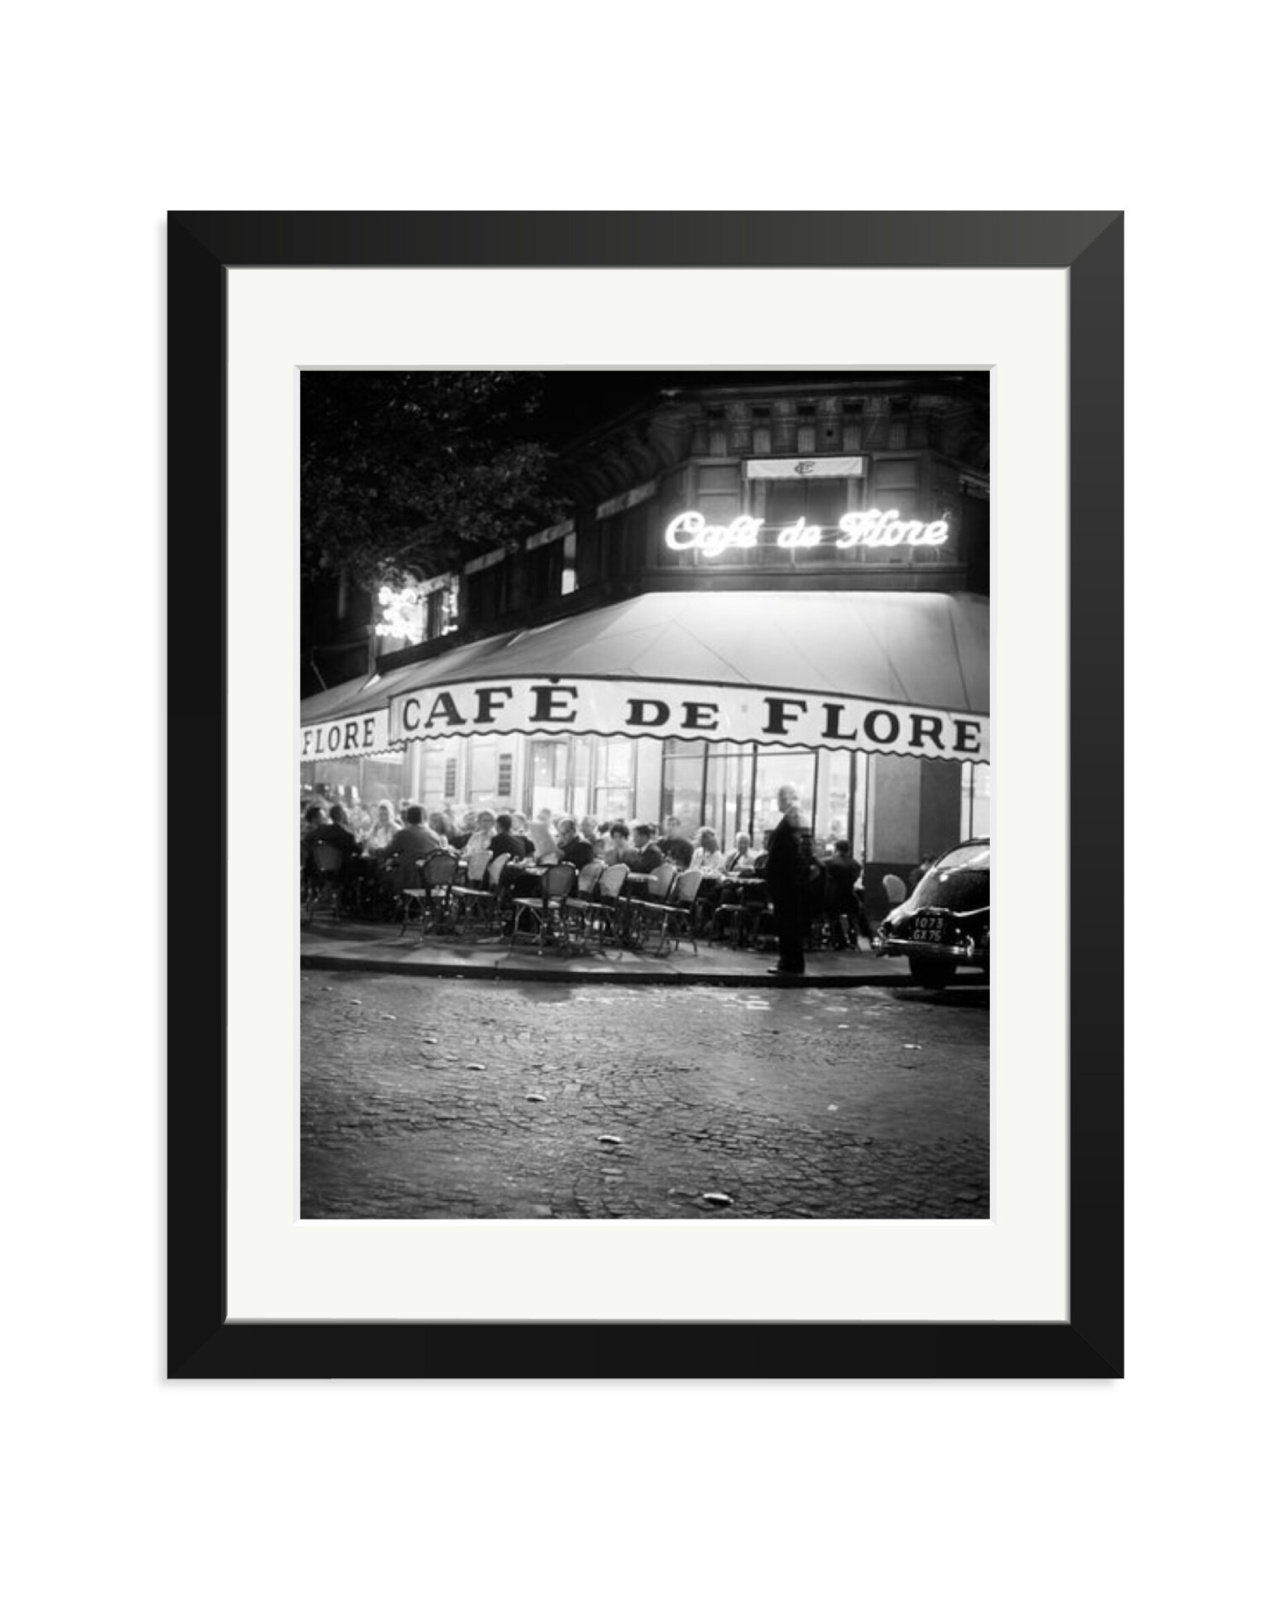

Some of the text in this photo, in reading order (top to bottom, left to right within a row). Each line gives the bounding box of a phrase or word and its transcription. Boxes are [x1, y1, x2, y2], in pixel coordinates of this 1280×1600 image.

[777, 516, 822, 548] de
[836, 508, 949, 549] Flore
[402, 677, 982, 754] CAFÉ DE FLORE
[301, 717, 376, 756] FLORE
